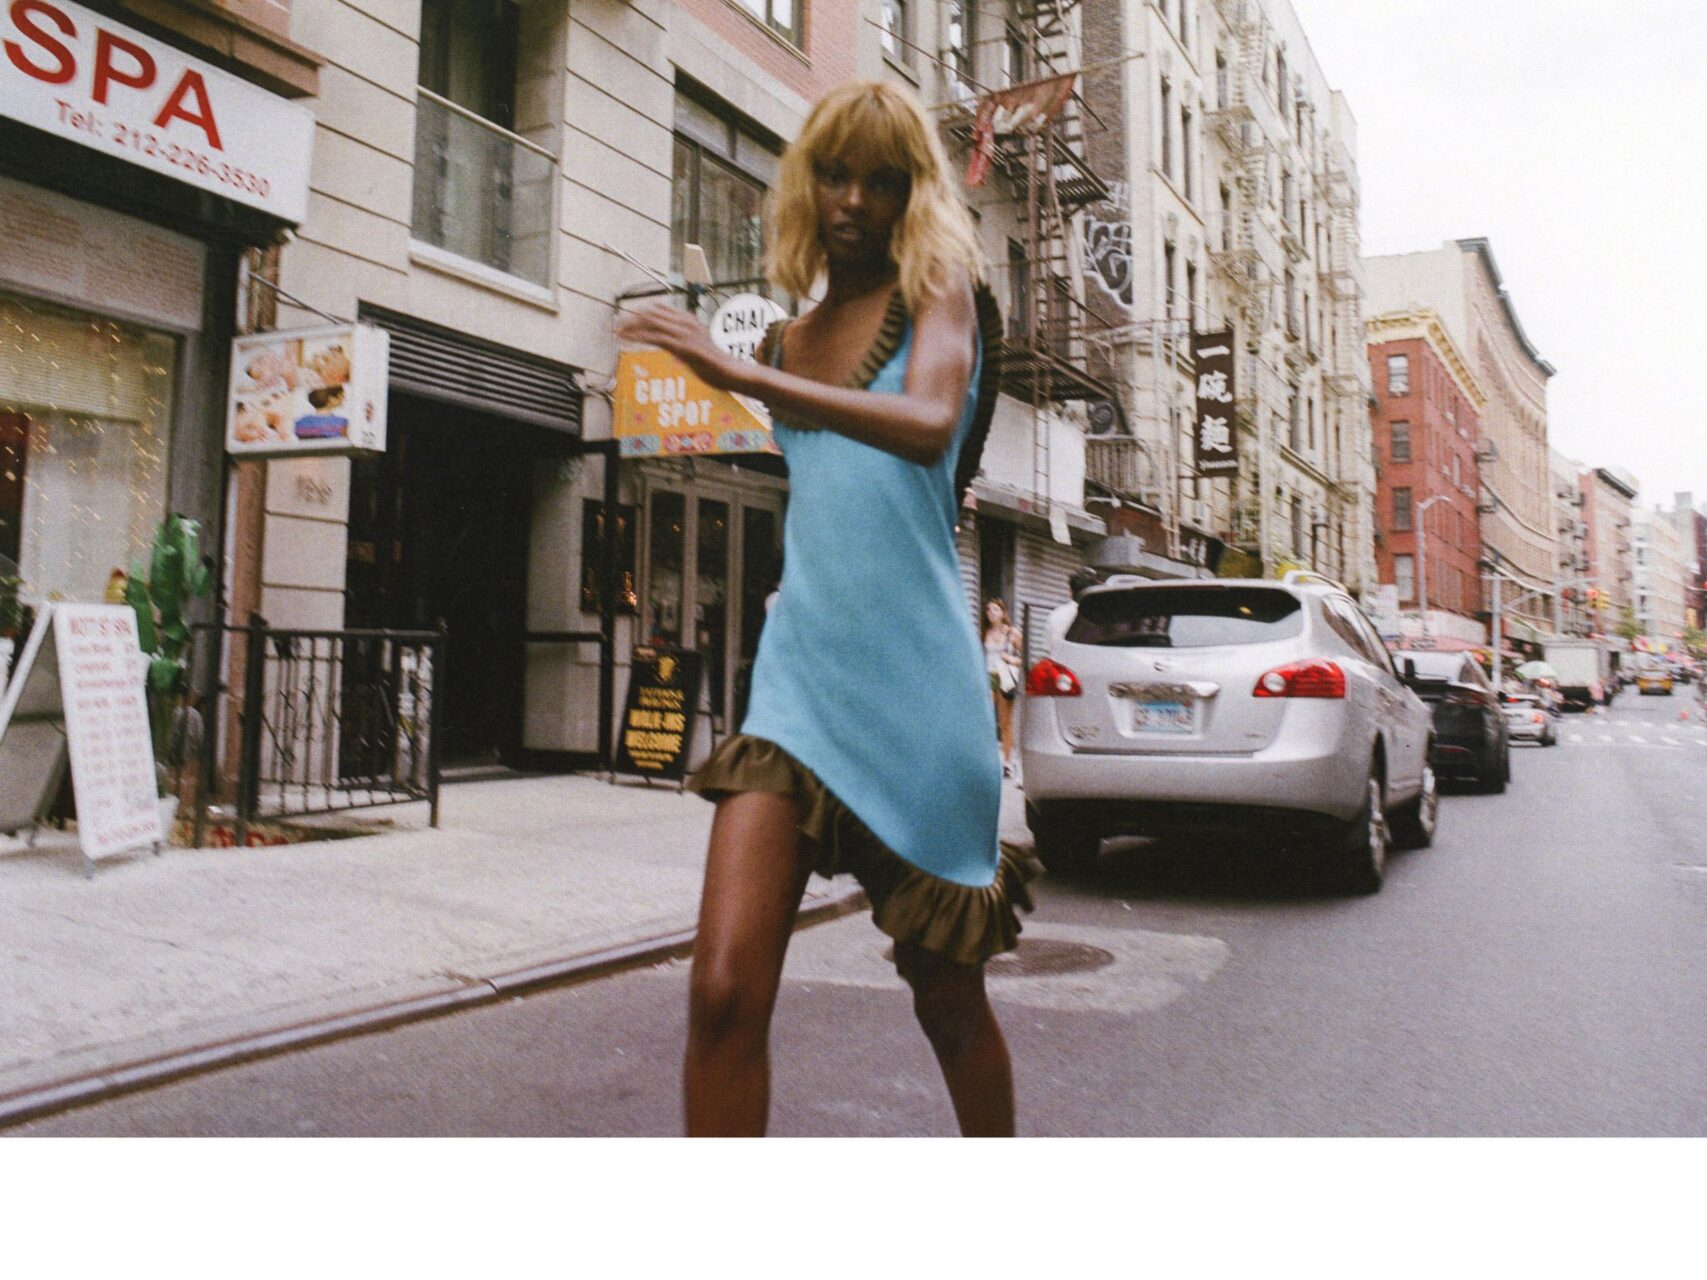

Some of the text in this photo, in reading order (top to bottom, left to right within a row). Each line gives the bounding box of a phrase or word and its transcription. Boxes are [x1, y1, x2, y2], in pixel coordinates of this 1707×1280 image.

[2, 0, 224, 151] SPA
[55, 98, 271, 198] Tel: 212-226-3530
[723, 308, 764, 333] CHAI
[635, 376, 686, 405] CHAI
[658, 399, 713, 428] SPOT
